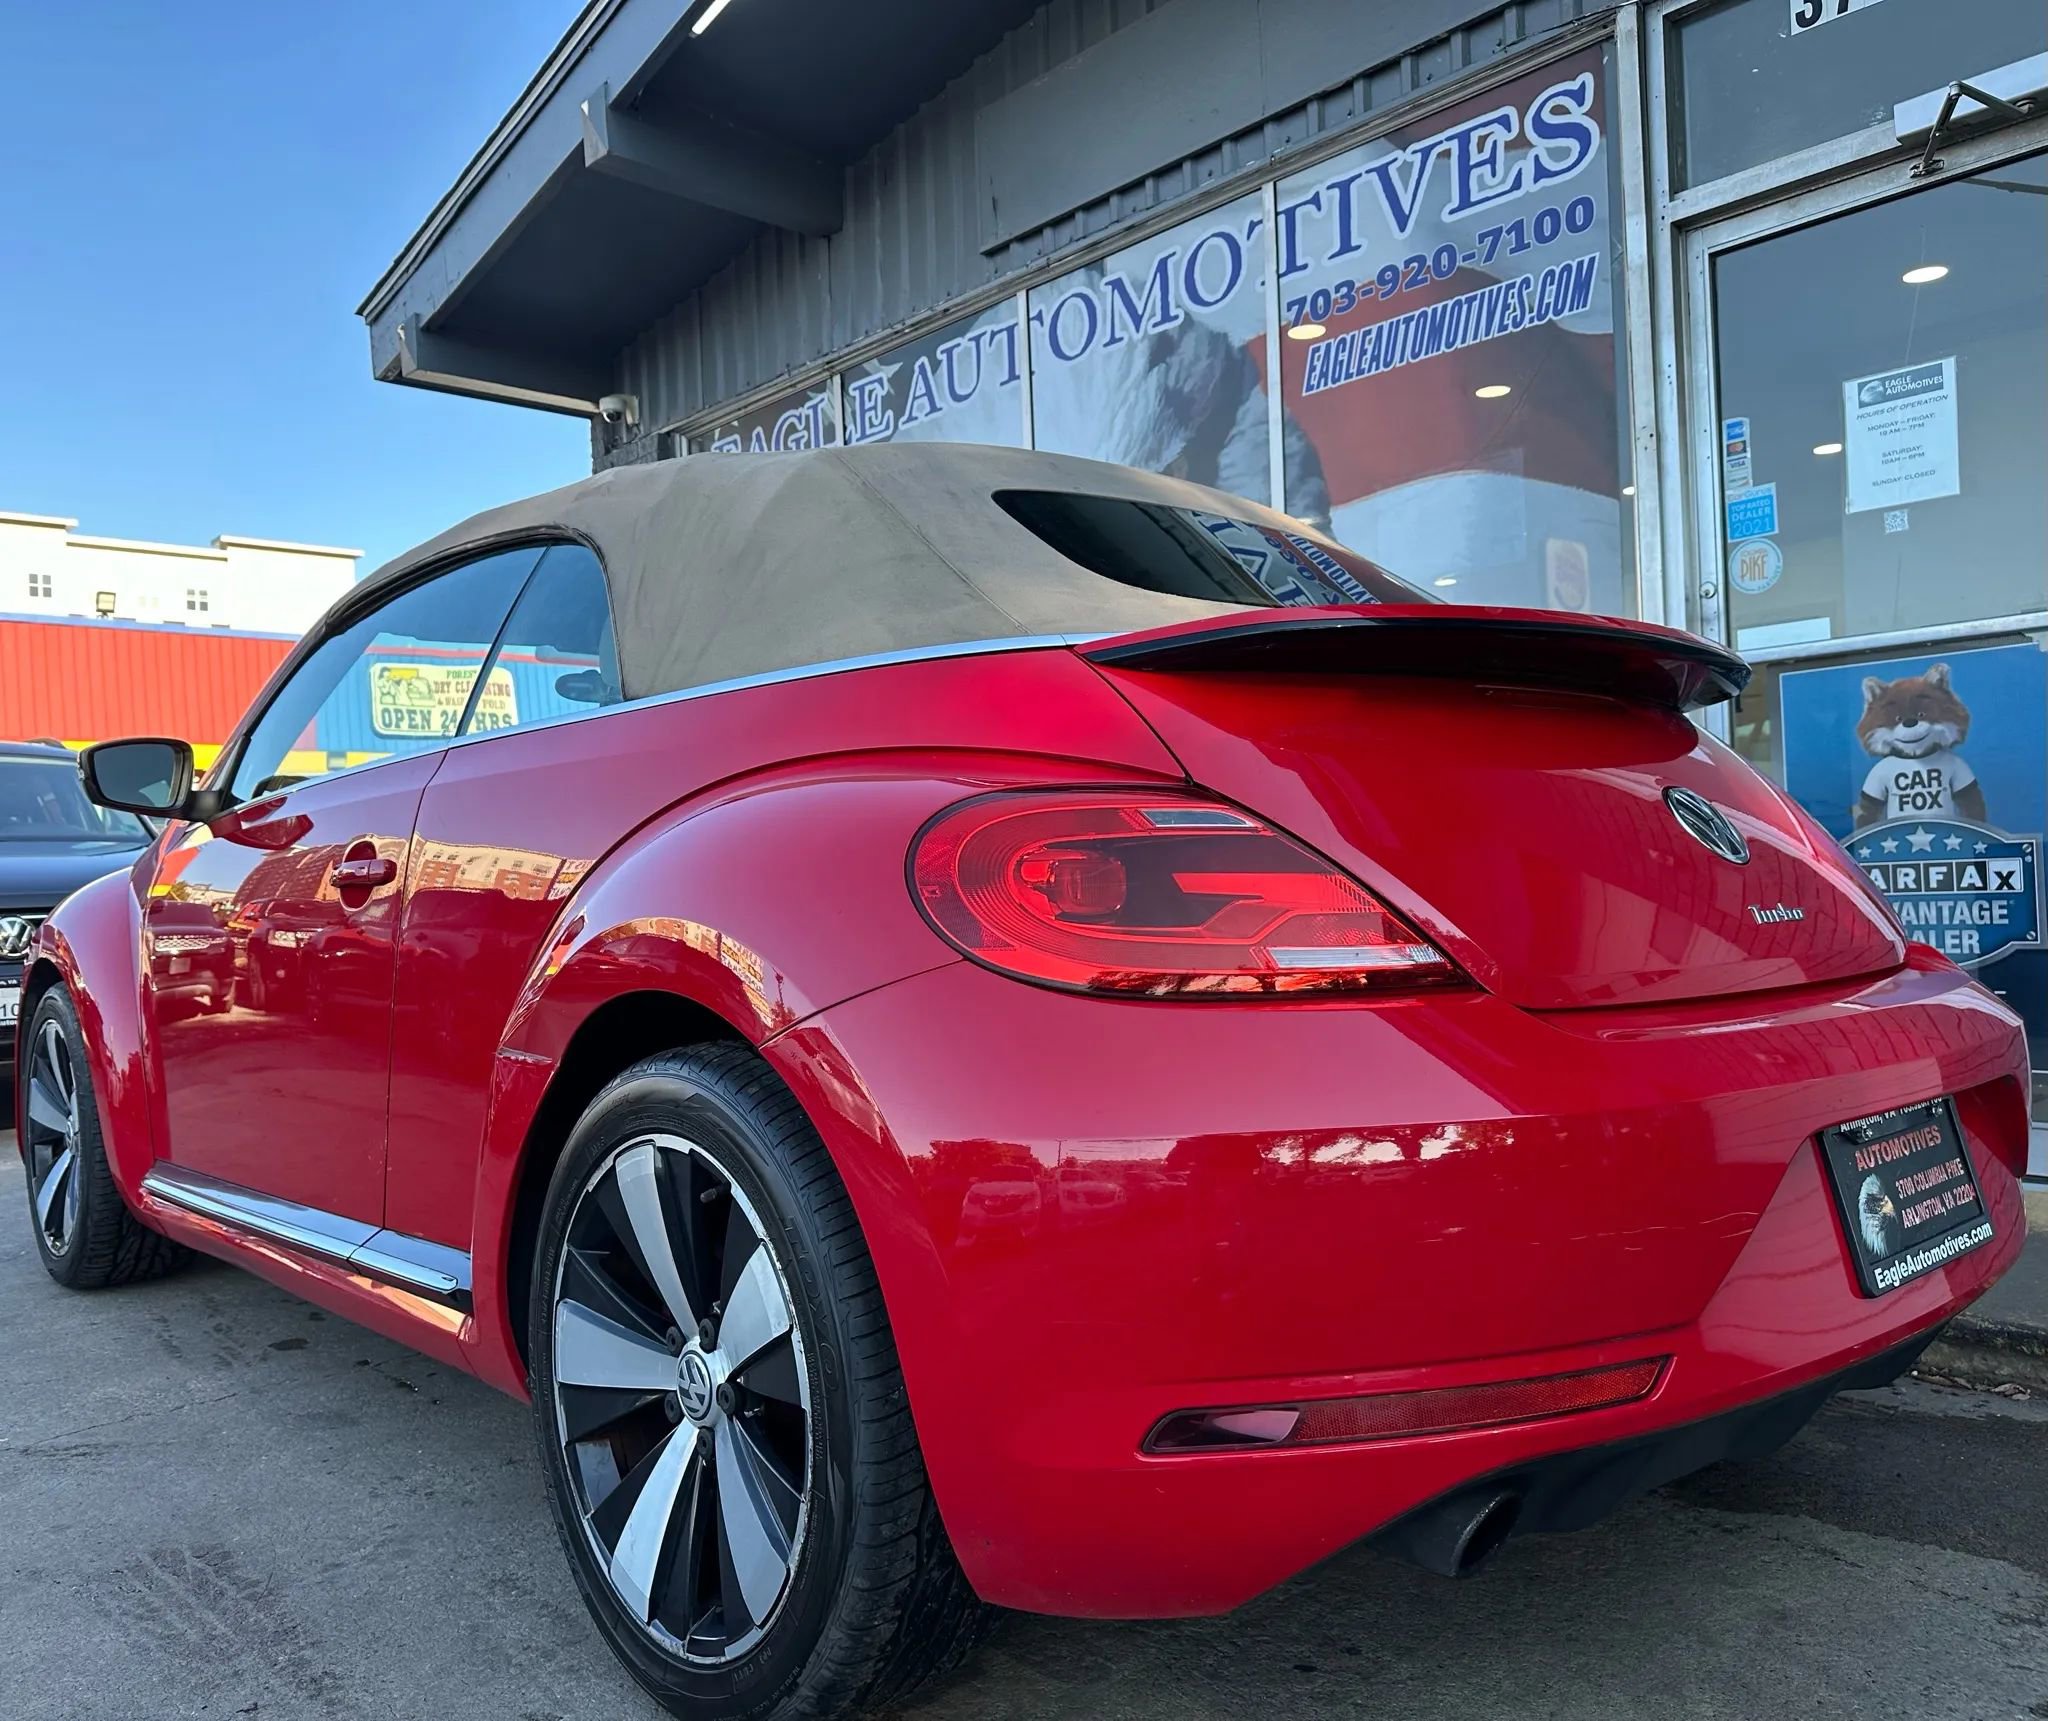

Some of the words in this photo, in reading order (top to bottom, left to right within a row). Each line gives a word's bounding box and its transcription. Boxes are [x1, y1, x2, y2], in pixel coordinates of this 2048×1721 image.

[899, 72, 1600, 428] AUTOMOTIVES
[1286, 195, 1596, 328] 703-920-7100
[1302, 252, 1600, 396] EAGLEAUTOMOTIVES.COM
[1885, 375, 1912, 389] EAGLE
[1885, 375, 1944, 396] AUTOMOTIVES
[1856, 408, 1886, 420] HOURS
[1886, 404, 1898, 414] OF
[1899, 394, 1948, 411] OPERATION
[1867, 420, 1899, 432] MONDAY
[1732, 504, 1745, 512] TOP
[1732, 507, 1772, 522] DEALER
[1733, 517, 1773, 538] 2021
[1740, 555, 1769, 582] PIKE
[433, 681, 451, 694] DRY
[381, 707, 432, 730] OPEN
[440, 708, 458, 730] 24
[475, 712, 512, 730] HRS
[1893, 768, 1943, 792] CAR
[1898, 790, 1944, 812] FOX
[1870, 864, 2017, 891] ARFAX
[1748, 903, 1804, 926] Turbo
[1855, 1124, 1942, 1171] AUTOMOTIVES
[1895, 1176, 1916, 1200] 3700
[1913, 1163, 1948, 1192] COLUMBIA
[1945, 1157, 1965, 1179] PIKE
[1901, 1195, 1947, 1229] ARLINGTON,
[1942, 1190, 1956, 1210] VA
[1953, 1182, 1976, 1206] 22204
[1873, 1221, 1993, 1288] EagleAutomotives.com
